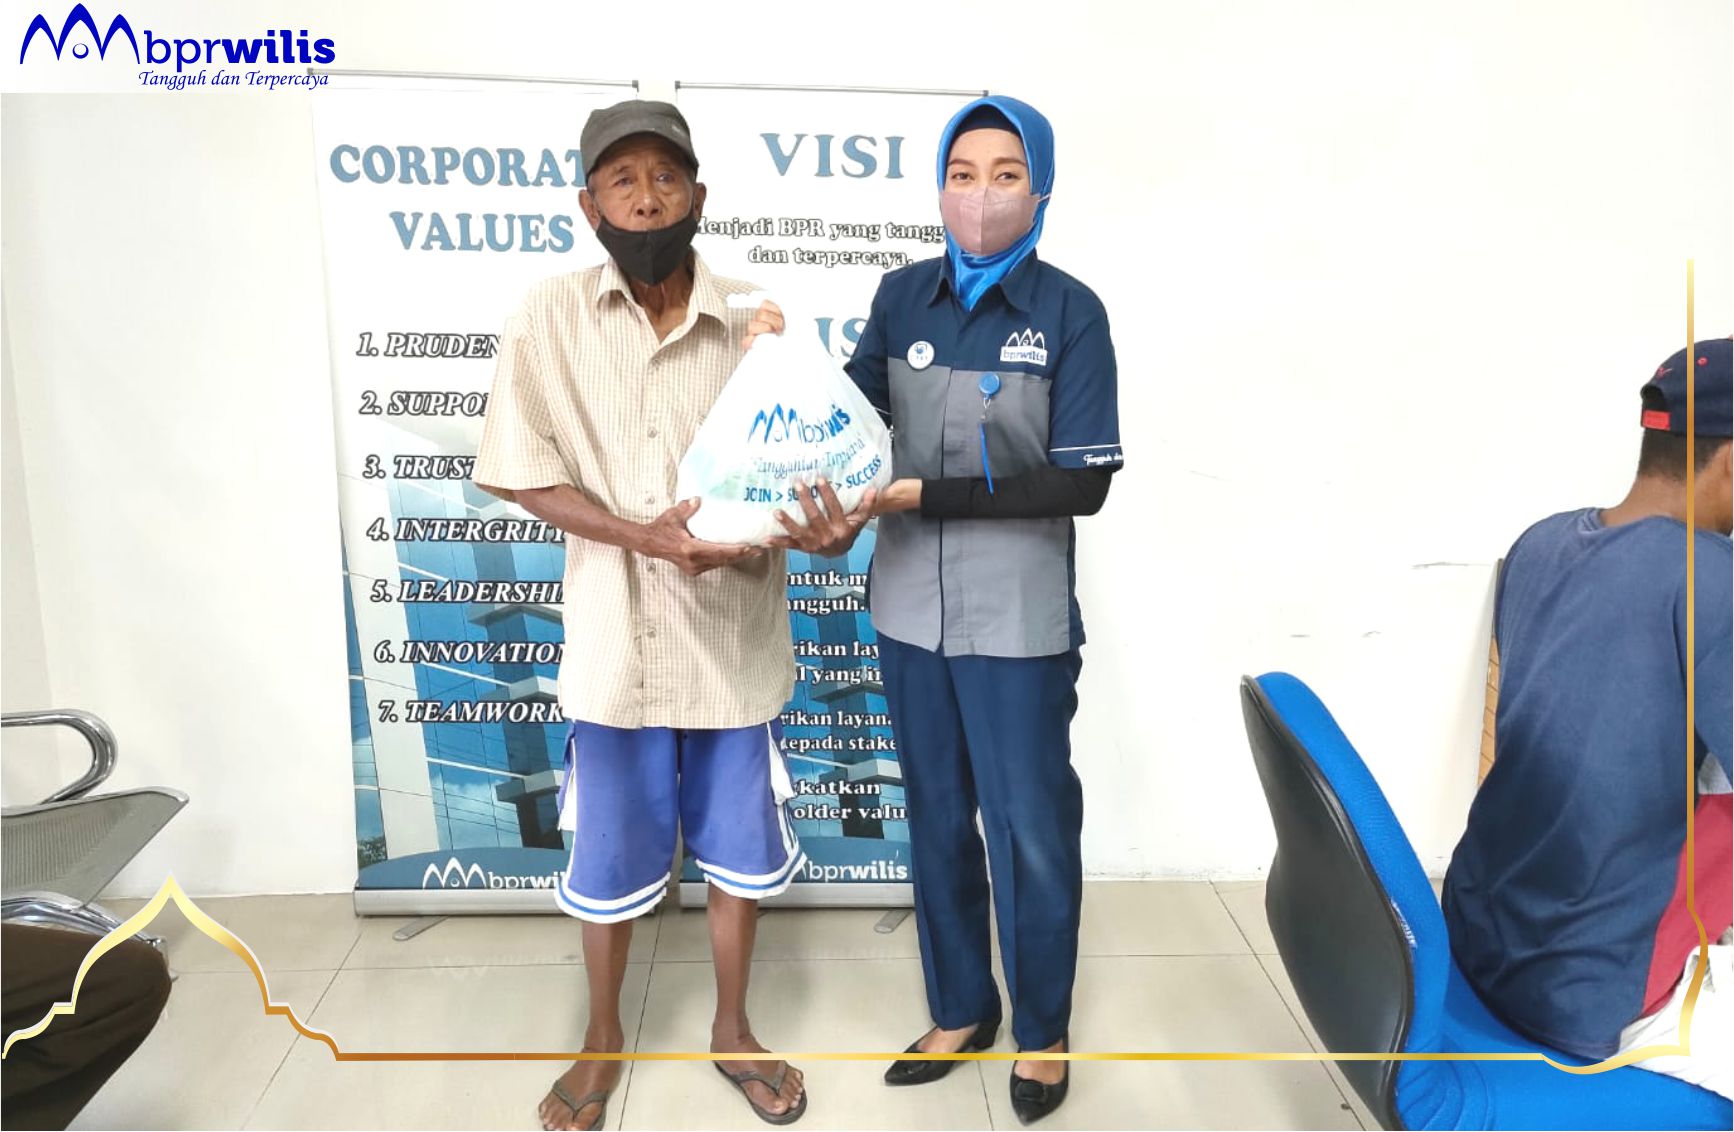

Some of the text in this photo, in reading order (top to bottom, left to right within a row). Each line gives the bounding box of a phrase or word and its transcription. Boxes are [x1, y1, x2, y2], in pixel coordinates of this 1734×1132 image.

[760, 132, 905, 179] VISI
[389, 211, 575, 254] VALUES
[778, 217, 826, 238] BPR
[829, 223, 881, 243] yang
[748, 245, 914, 270] dan terpercaya.
[356, 332, 379, 357] 1.
[359, 390, 489, 417] 2. SUPPO
[362, 455, 386, 479] 3.
[743, 486, 772, 502] JOIN
[366, 518, 389, 541] 4.
[370, 579, 392, 603] 5.
[786, 571, 842, 587] ntuk
[374, 640, 395, 663] 6.
[811, 668, 862, 685] yang
[379, 700, 565, 724] 7. TEAMWORK
[858, 804, 906, 820] valu
[808, 860, 908, 882] bprwilis
